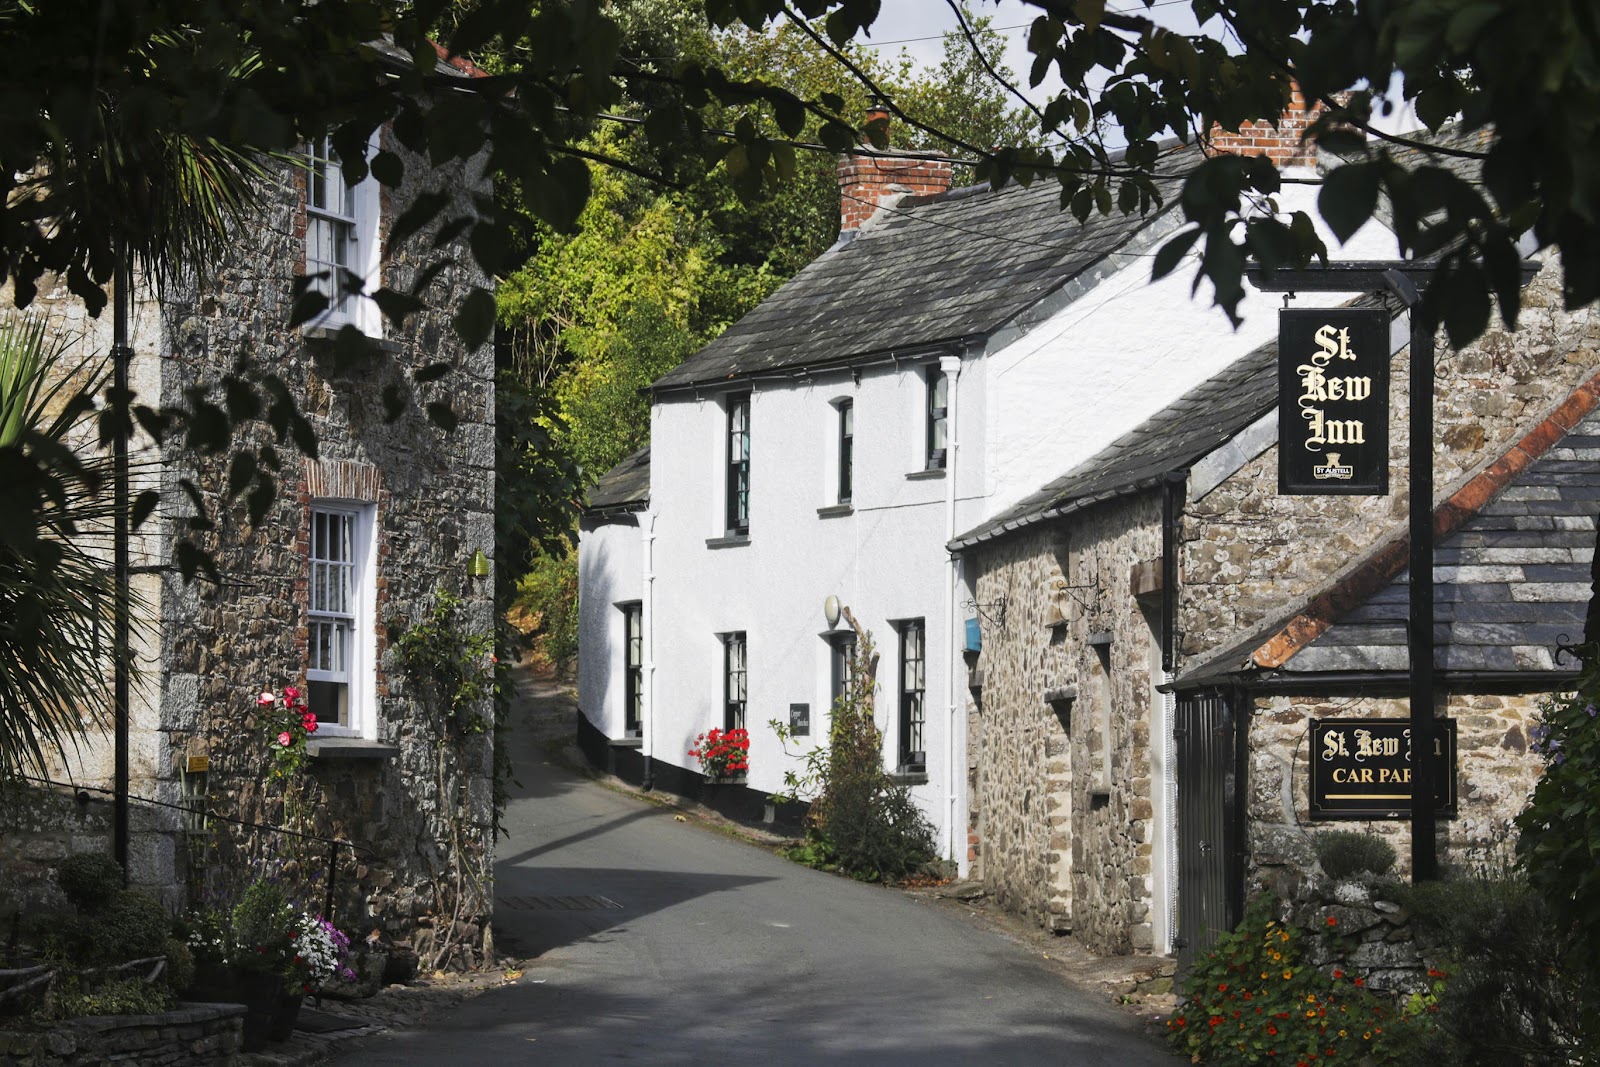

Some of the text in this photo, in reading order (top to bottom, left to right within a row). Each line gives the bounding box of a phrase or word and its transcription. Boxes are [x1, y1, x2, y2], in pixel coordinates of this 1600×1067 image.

[1311, 324, 1357, 367] St.
[1296, 364, 1372, 409] Kew
[1301, 408, 1366, 452] Inn
[1322, 729, 1350, 762] St.
[1354, 728, 1399, 763] Kew
[1332, 768, 1411, 783] CAR PAR
